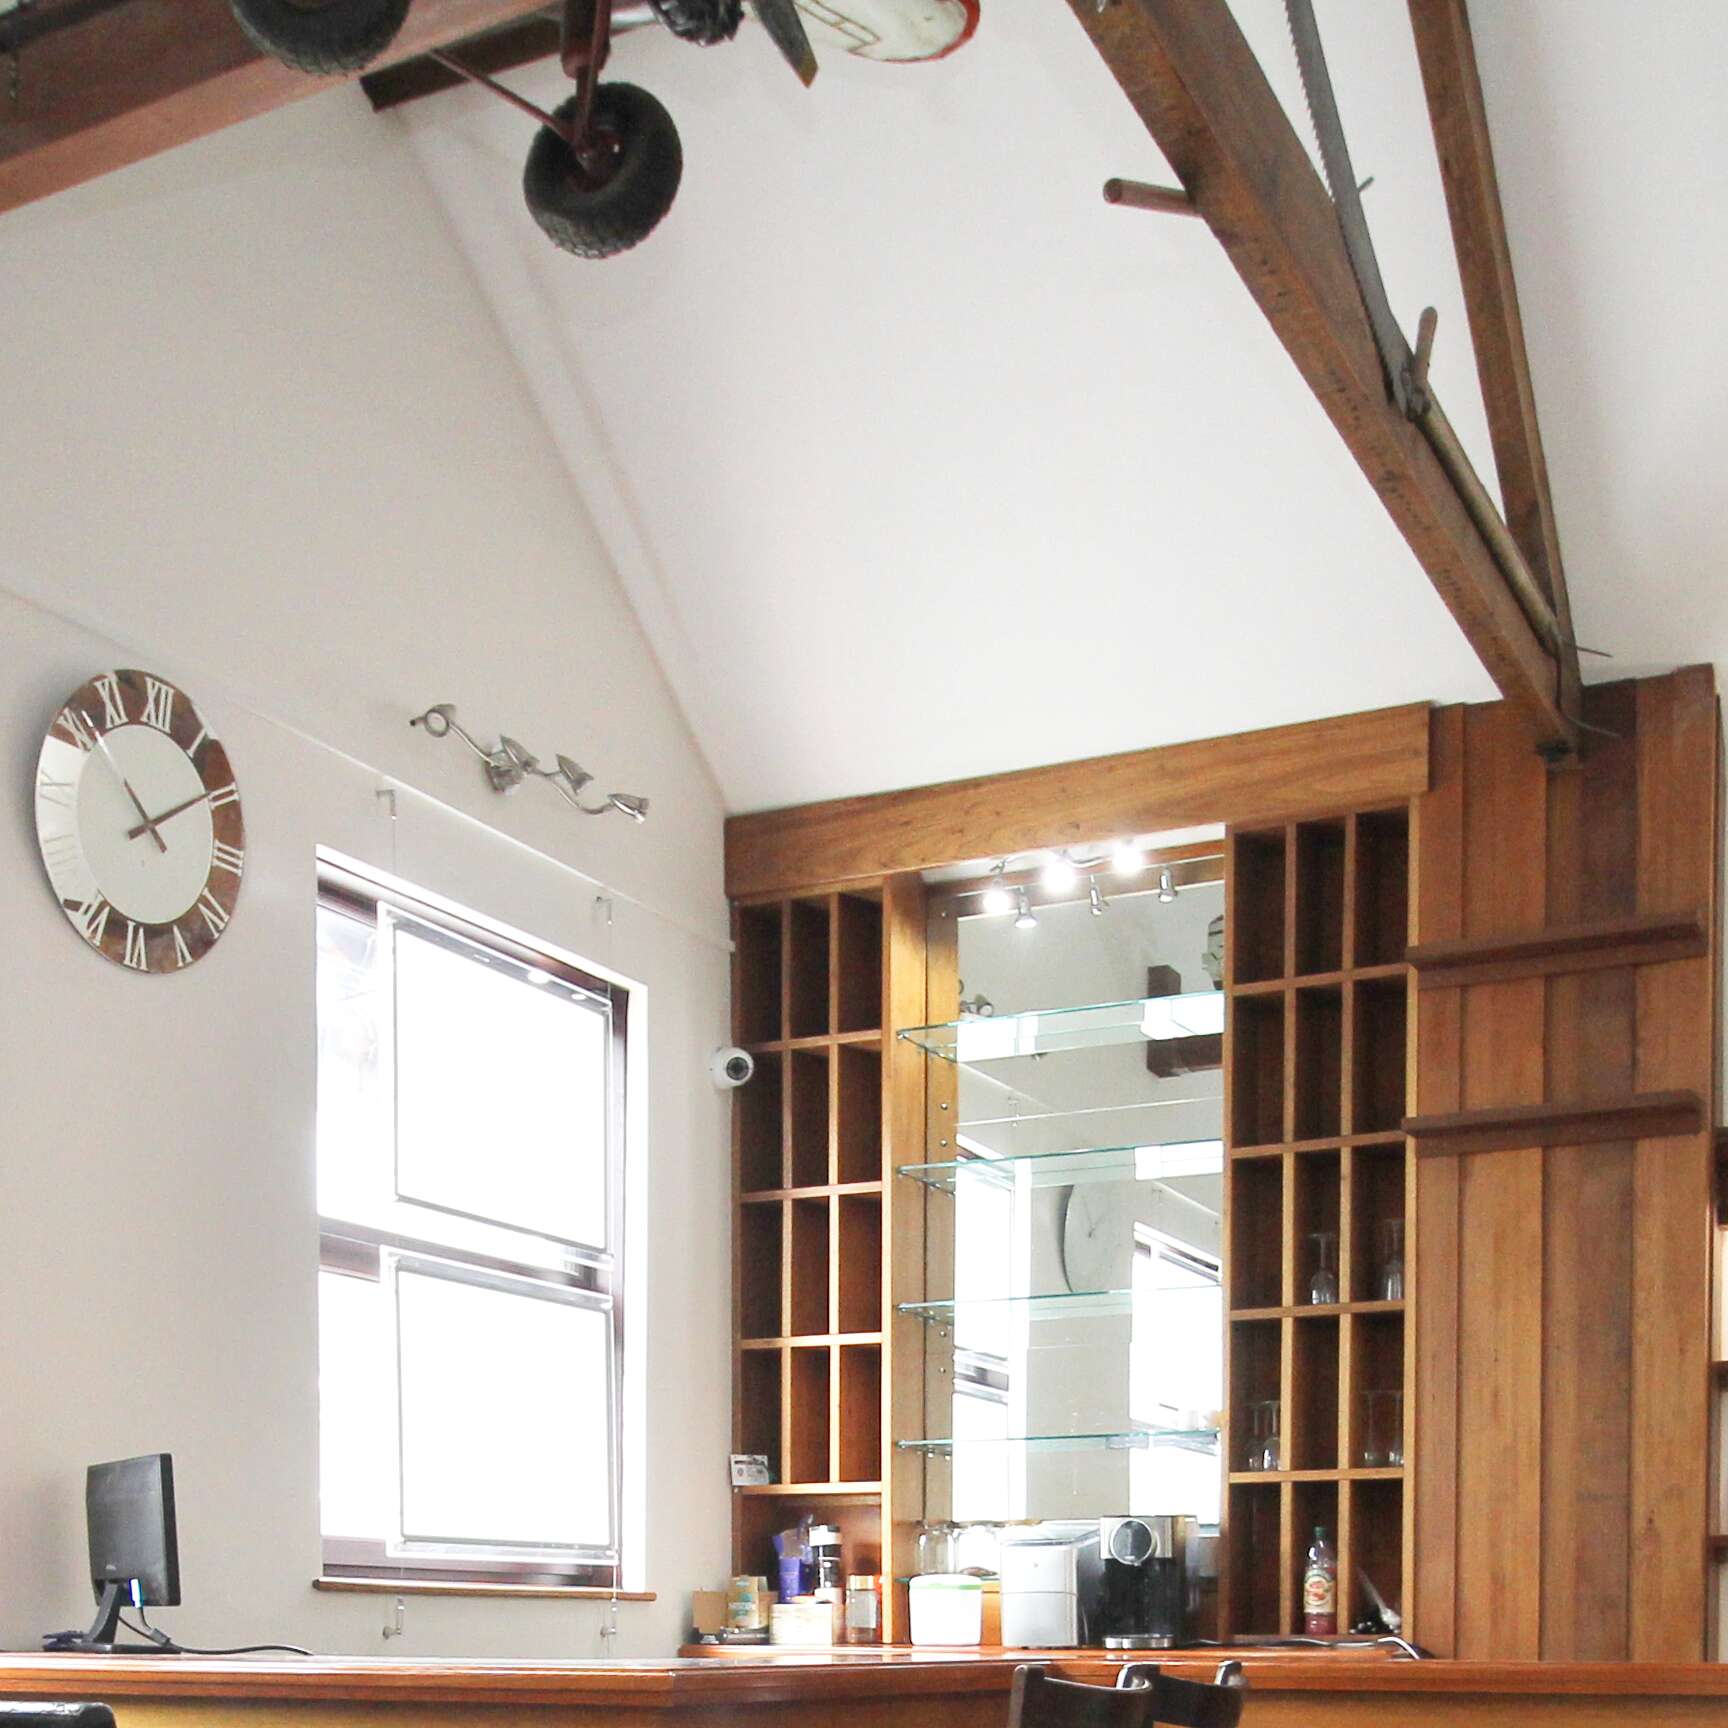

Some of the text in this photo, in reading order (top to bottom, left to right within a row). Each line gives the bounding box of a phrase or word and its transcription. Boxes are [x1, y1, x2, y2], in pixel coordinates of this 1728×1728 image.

[94, 671, 129, 729] XI
[139, 676, 174, 734] XII
[208, 781, 240, 811] II
[212, 839, 244, 877] III
[123, 920, 149, 972] VI
[173, 924, 193, 968] V
